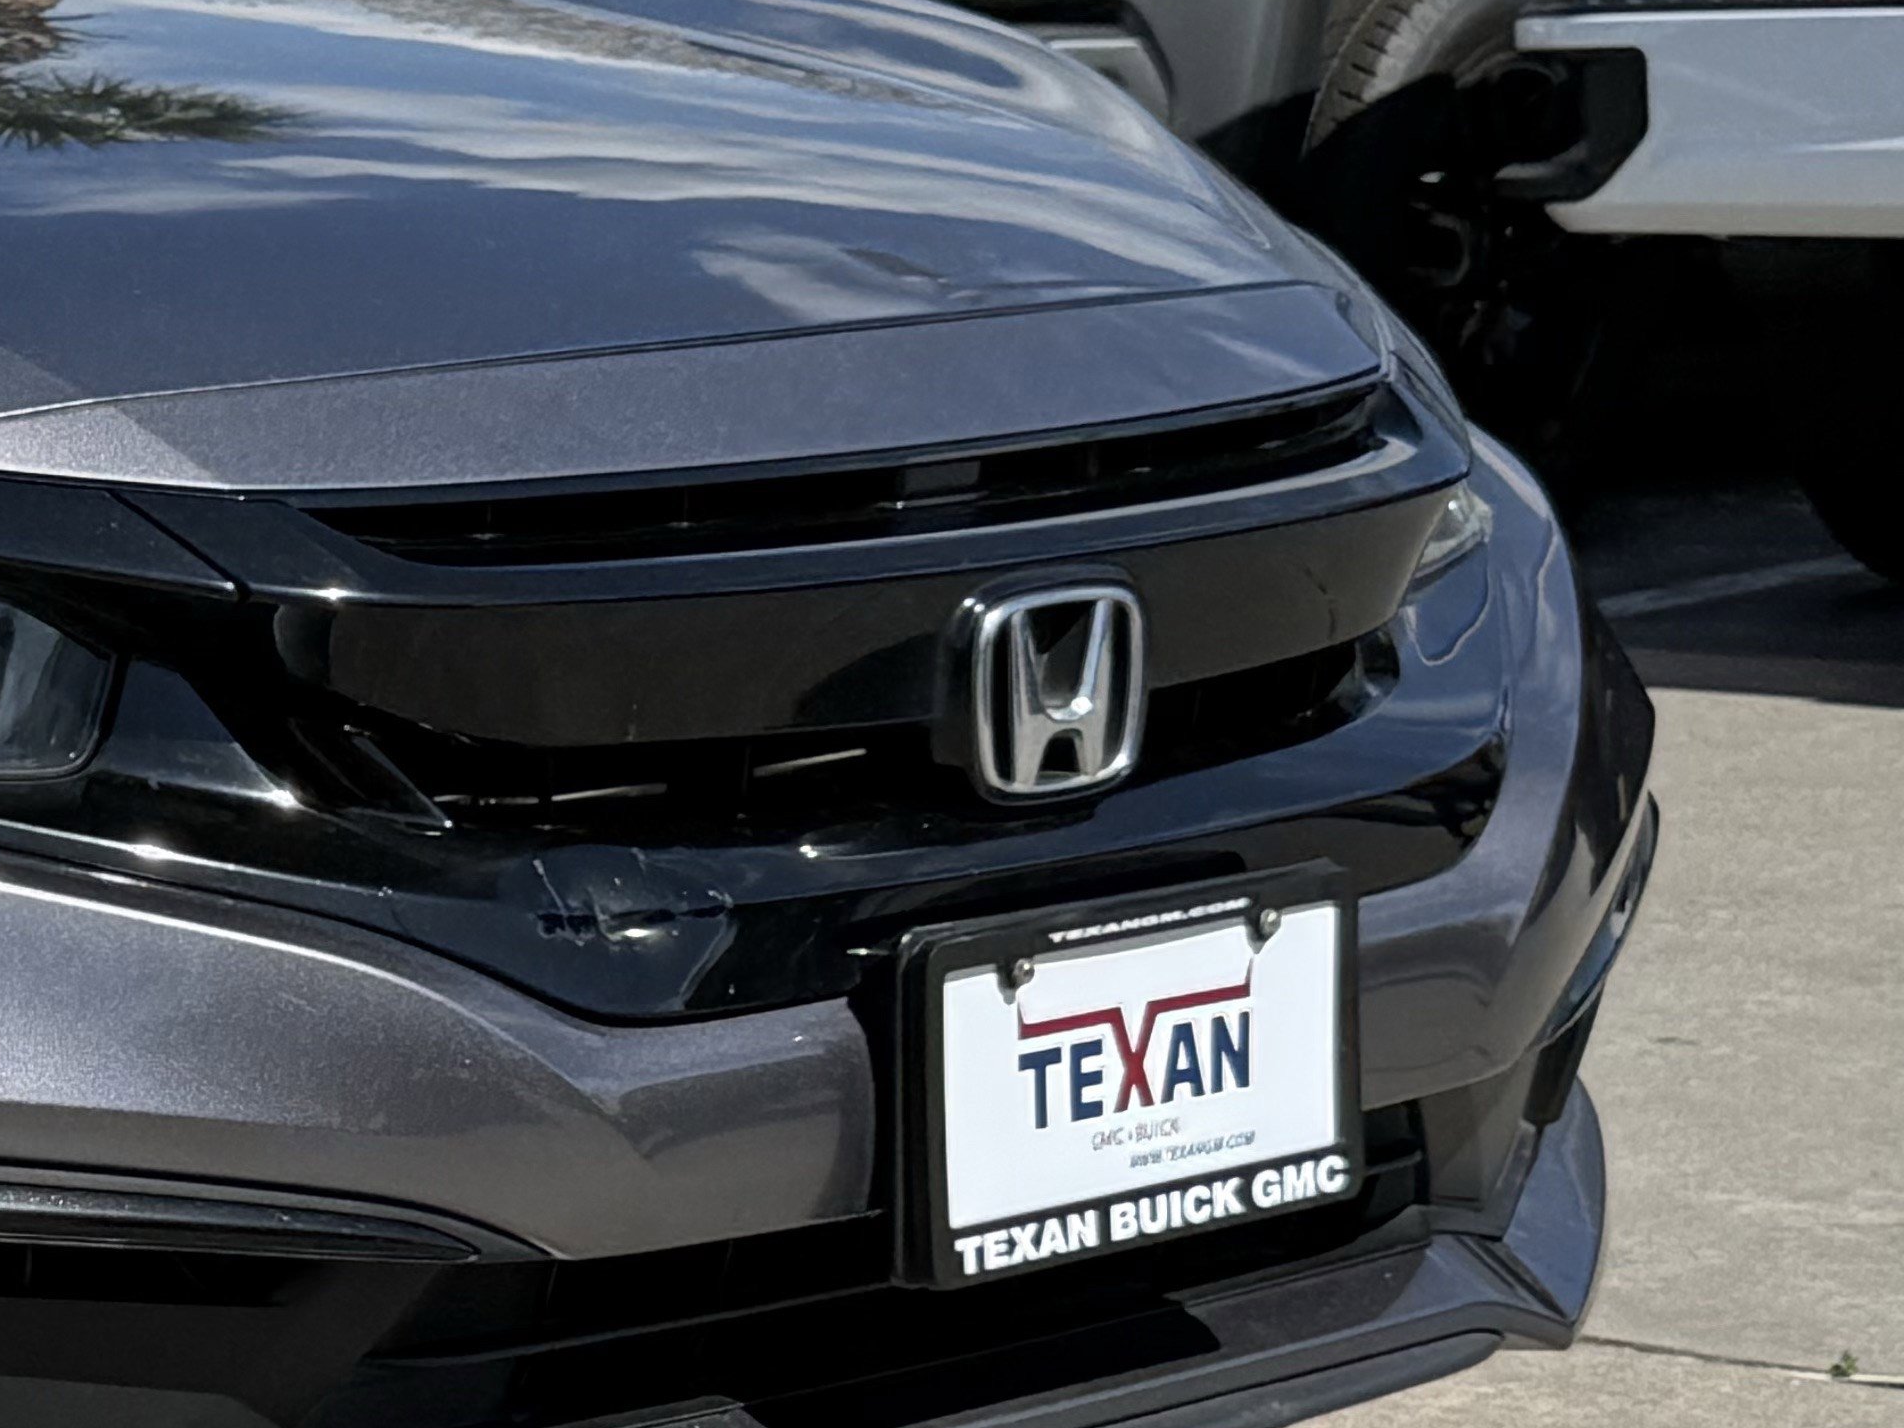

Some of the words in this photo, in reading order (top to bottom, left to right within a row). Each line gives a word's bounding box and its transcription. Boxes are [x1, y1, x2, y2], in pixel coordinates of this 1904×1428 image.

[1048, 897, 1252, 943] TEXANGM.COM
[1017, 1000, 1251, 1129] TEXAN
[954, 1209, 1100, 1275] TEXAN
[1110, 1175, 1247, 1243] BUICK
[1252, 1153, 1350, 1210] GMC
